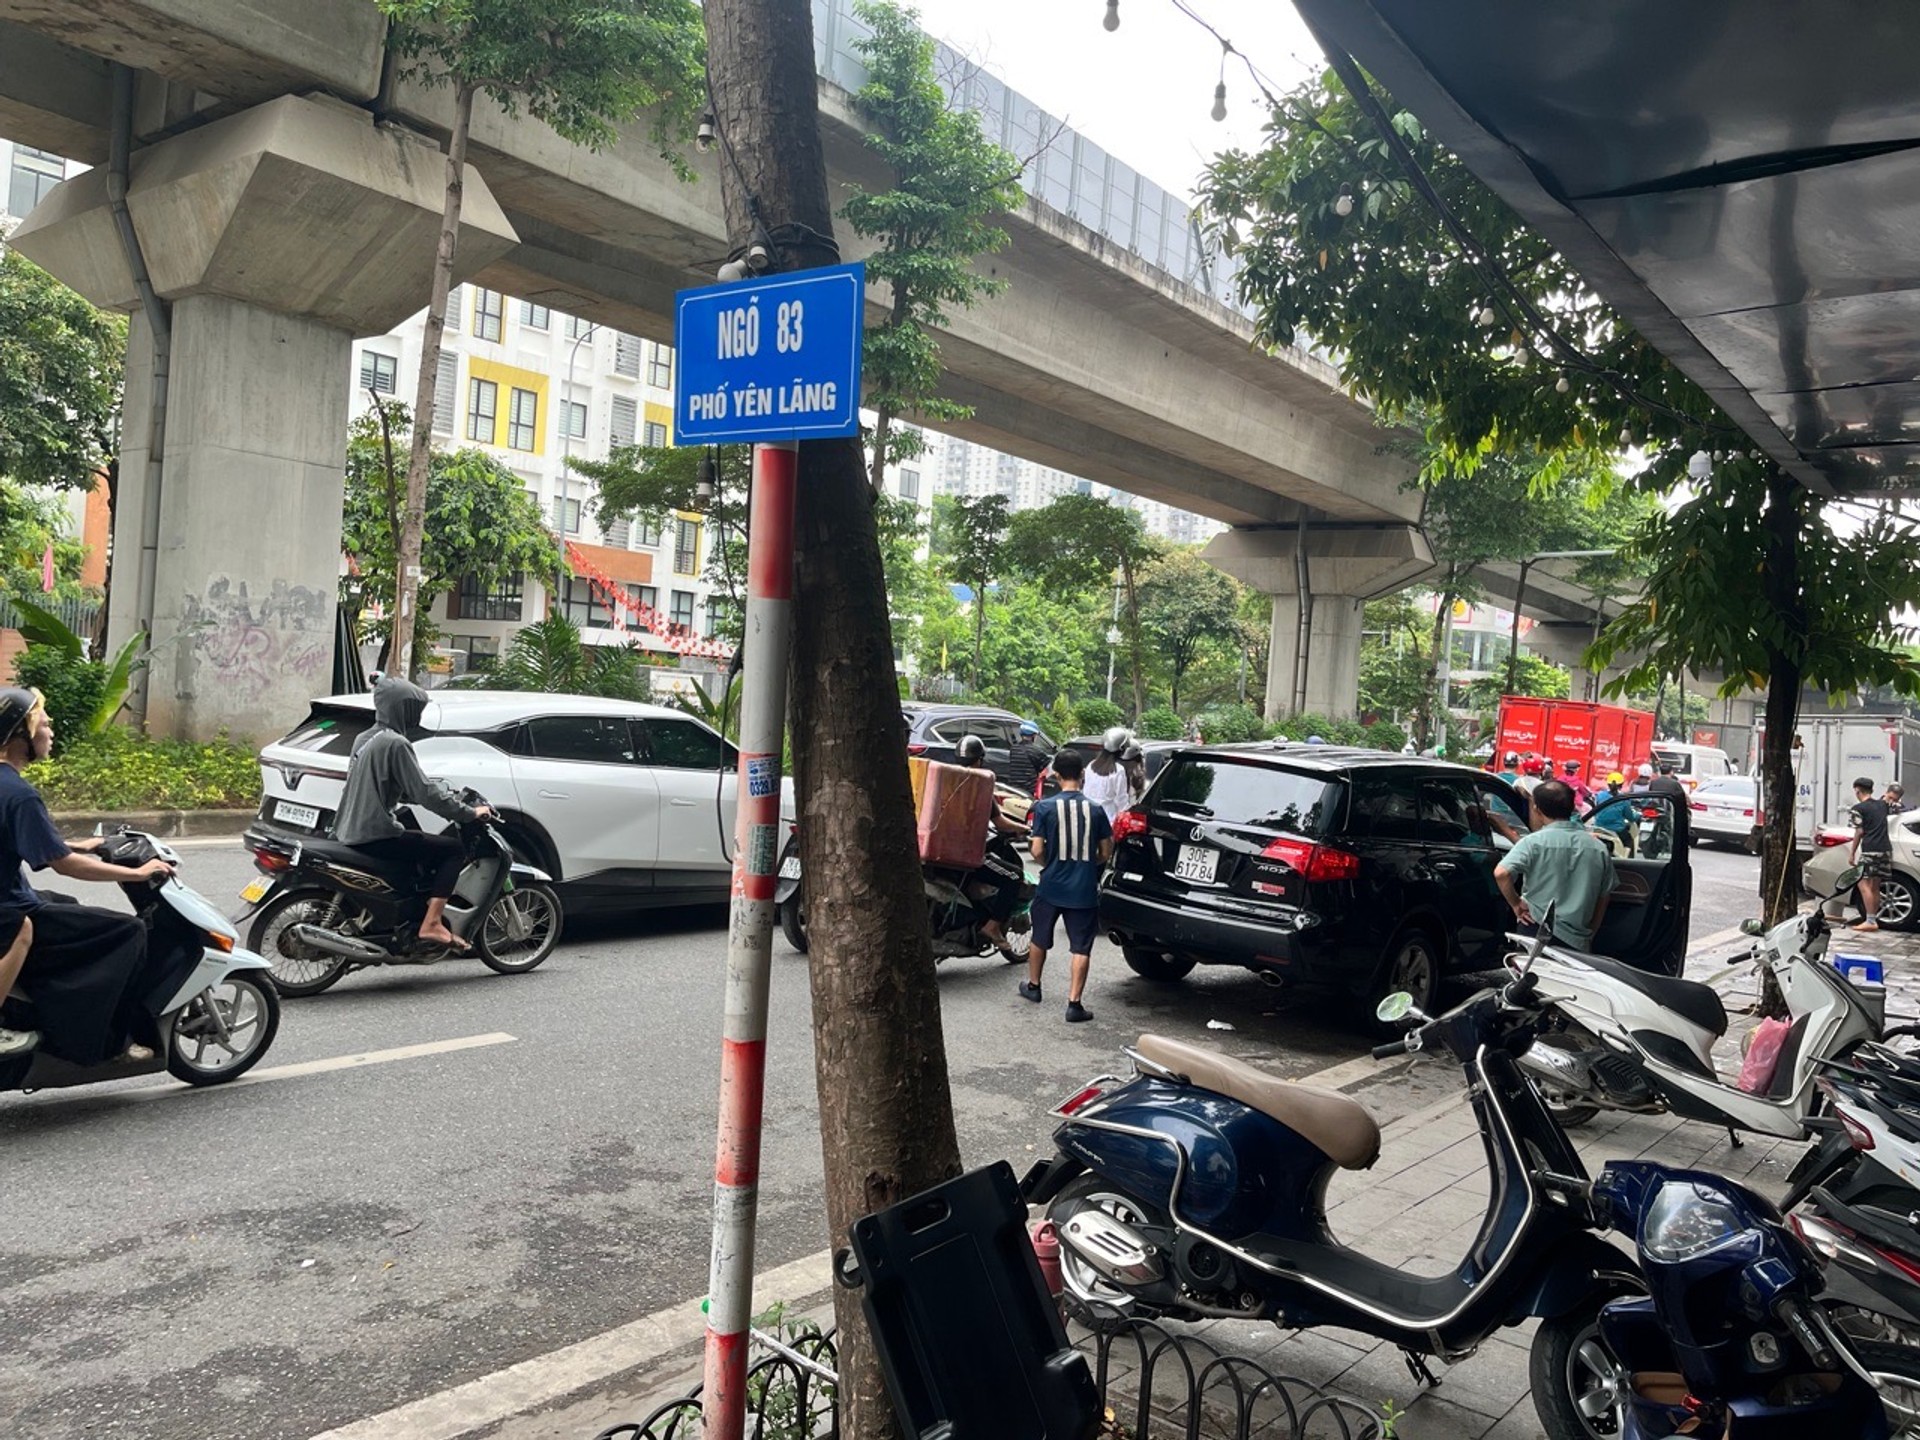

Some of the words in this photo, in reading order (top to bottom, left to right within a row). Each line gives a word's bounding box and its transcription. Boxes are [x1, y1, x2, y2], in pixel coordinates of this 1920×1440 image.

[718, 295, 760, 360] NGÕ
[776, 300, 804, 354] 83
[689, 381, 729, 421] PHỐ
[733, 382, 772, 418] YÊN
[778, 378, 837, 414] LÃNG
[1176, 860, 1213, 880] 617.84
[1187, 847, 1211, 864] 30E
